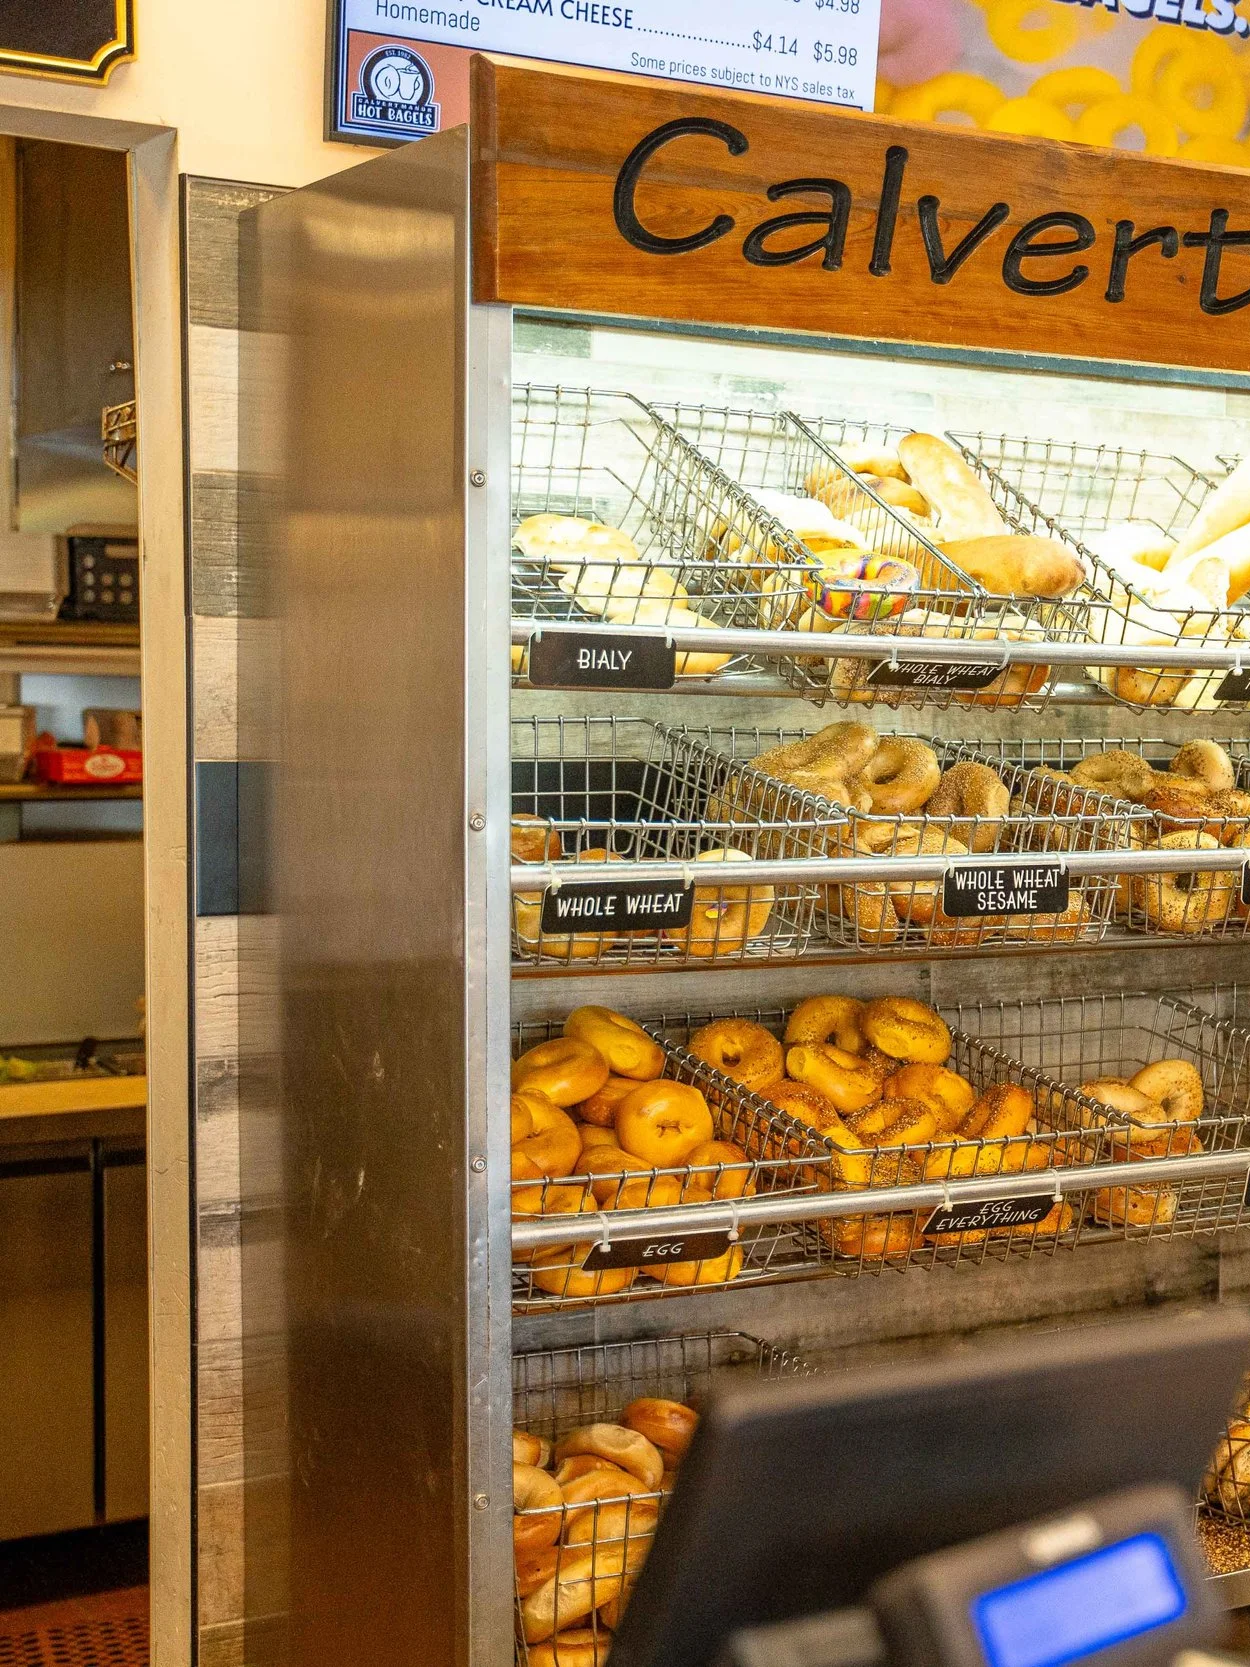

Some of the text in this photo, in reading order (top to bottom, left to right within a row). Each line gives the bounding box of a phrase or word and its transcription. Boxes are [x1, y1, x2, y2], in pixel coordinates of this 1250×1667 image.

[376, 0, 481, 32] Homemade
[560, 0, 634, 29] CHEESE
[752, 30, 799, 56] $4.14
[813, 40, 858, 66] $5.98
[630, 51, 855, 100] Some prices subject to NYS sales tax
[358, 104, 432, 126] HOT BAGELS
[577, 648, 633, 672] BIALY
[890, 662, 998, 676] WHOLE WHEAT
[913, 673, 958, 685] BIALY
[955, 868, 1060, 891] WHOLE WHEAT
[556, 893, 684, 918] WHOLE WHEAT
[977, 889, 1038, 911] SESAME
[979, 1200, 1017, 1215] EGG
[935, 1208, 1043, 1230] EVERYTHING
[641, 1242, 686, 1257] EGG
